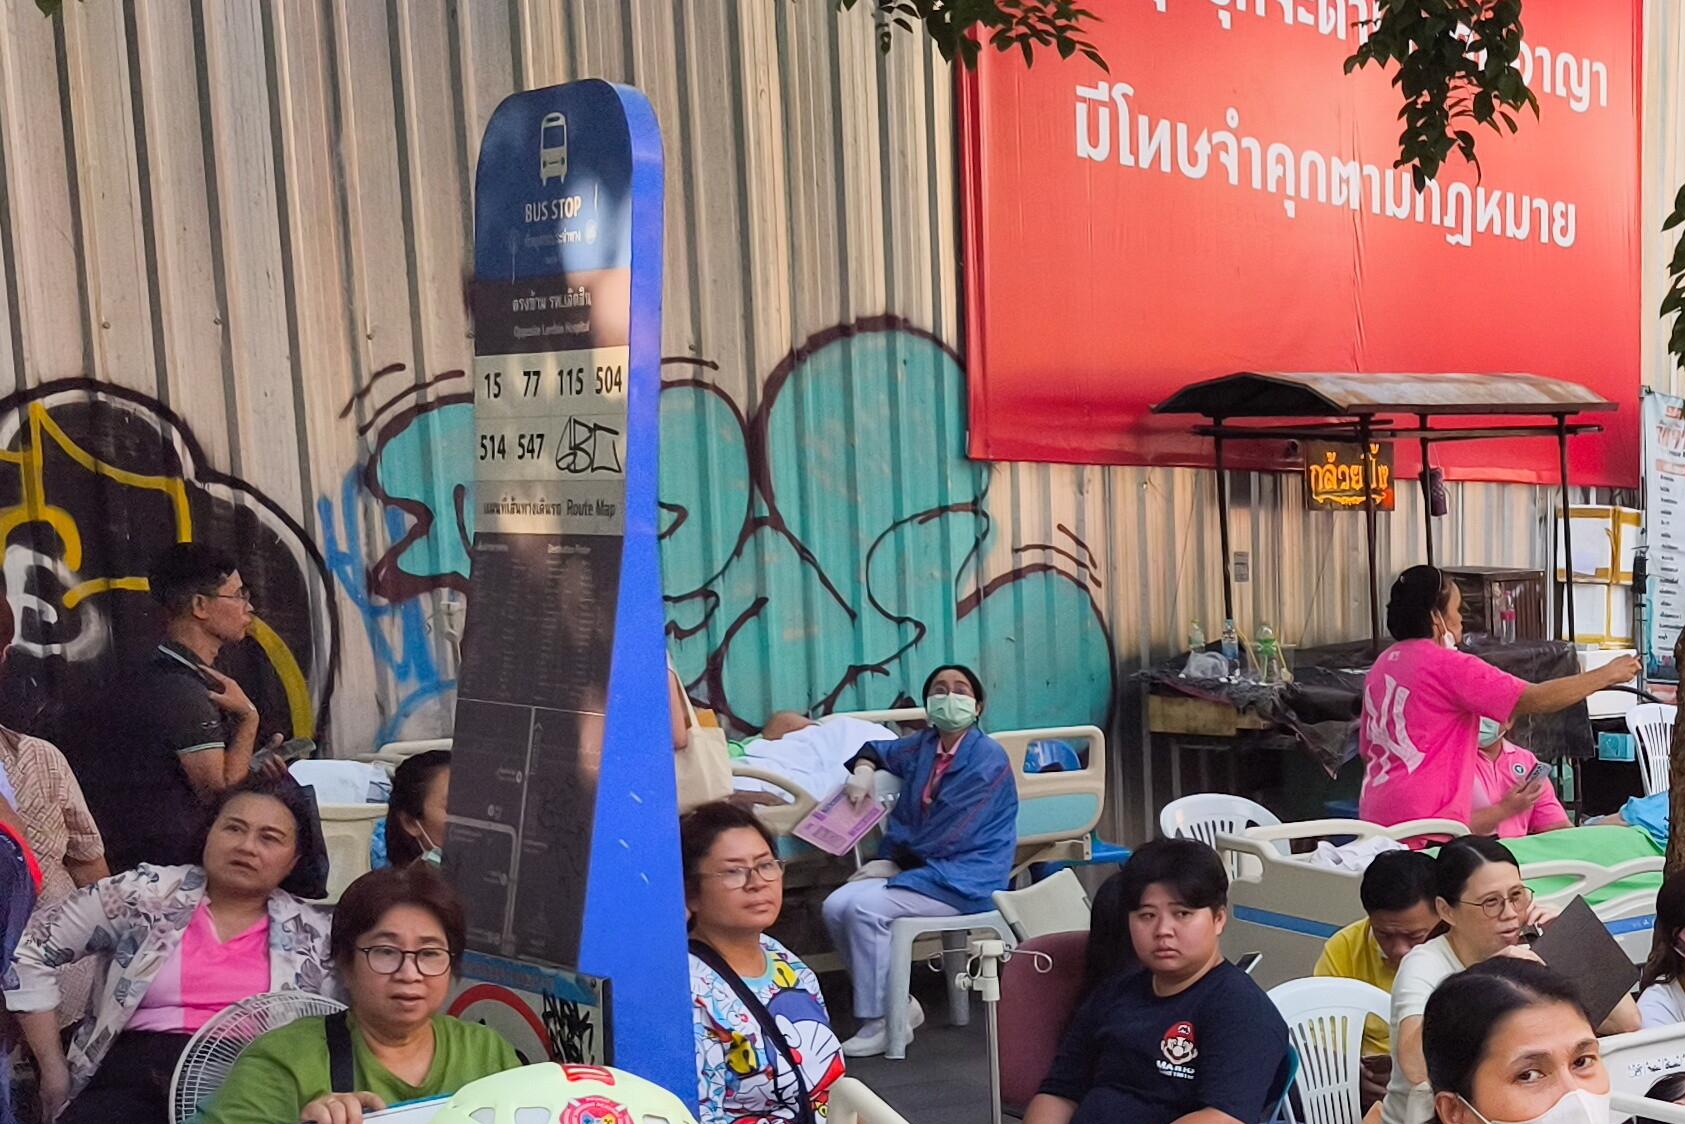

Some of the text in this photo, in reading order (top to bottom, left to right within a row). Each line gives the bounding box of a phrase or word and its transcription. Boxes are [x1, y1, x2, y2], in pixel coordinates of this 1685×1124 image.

[1076, 83, 1576, 248] มีโทษจำคุกตามกฎหมาย
[525, 196, 582, 223] BUS STOP
[484, 365, 623, 399] 15 77 115 504
[479, 434, 506, 460] 514
[517, 434, 545, 460] 547
[566, 499, 593, 516] Route
[596, 498, 615, 518] Map
